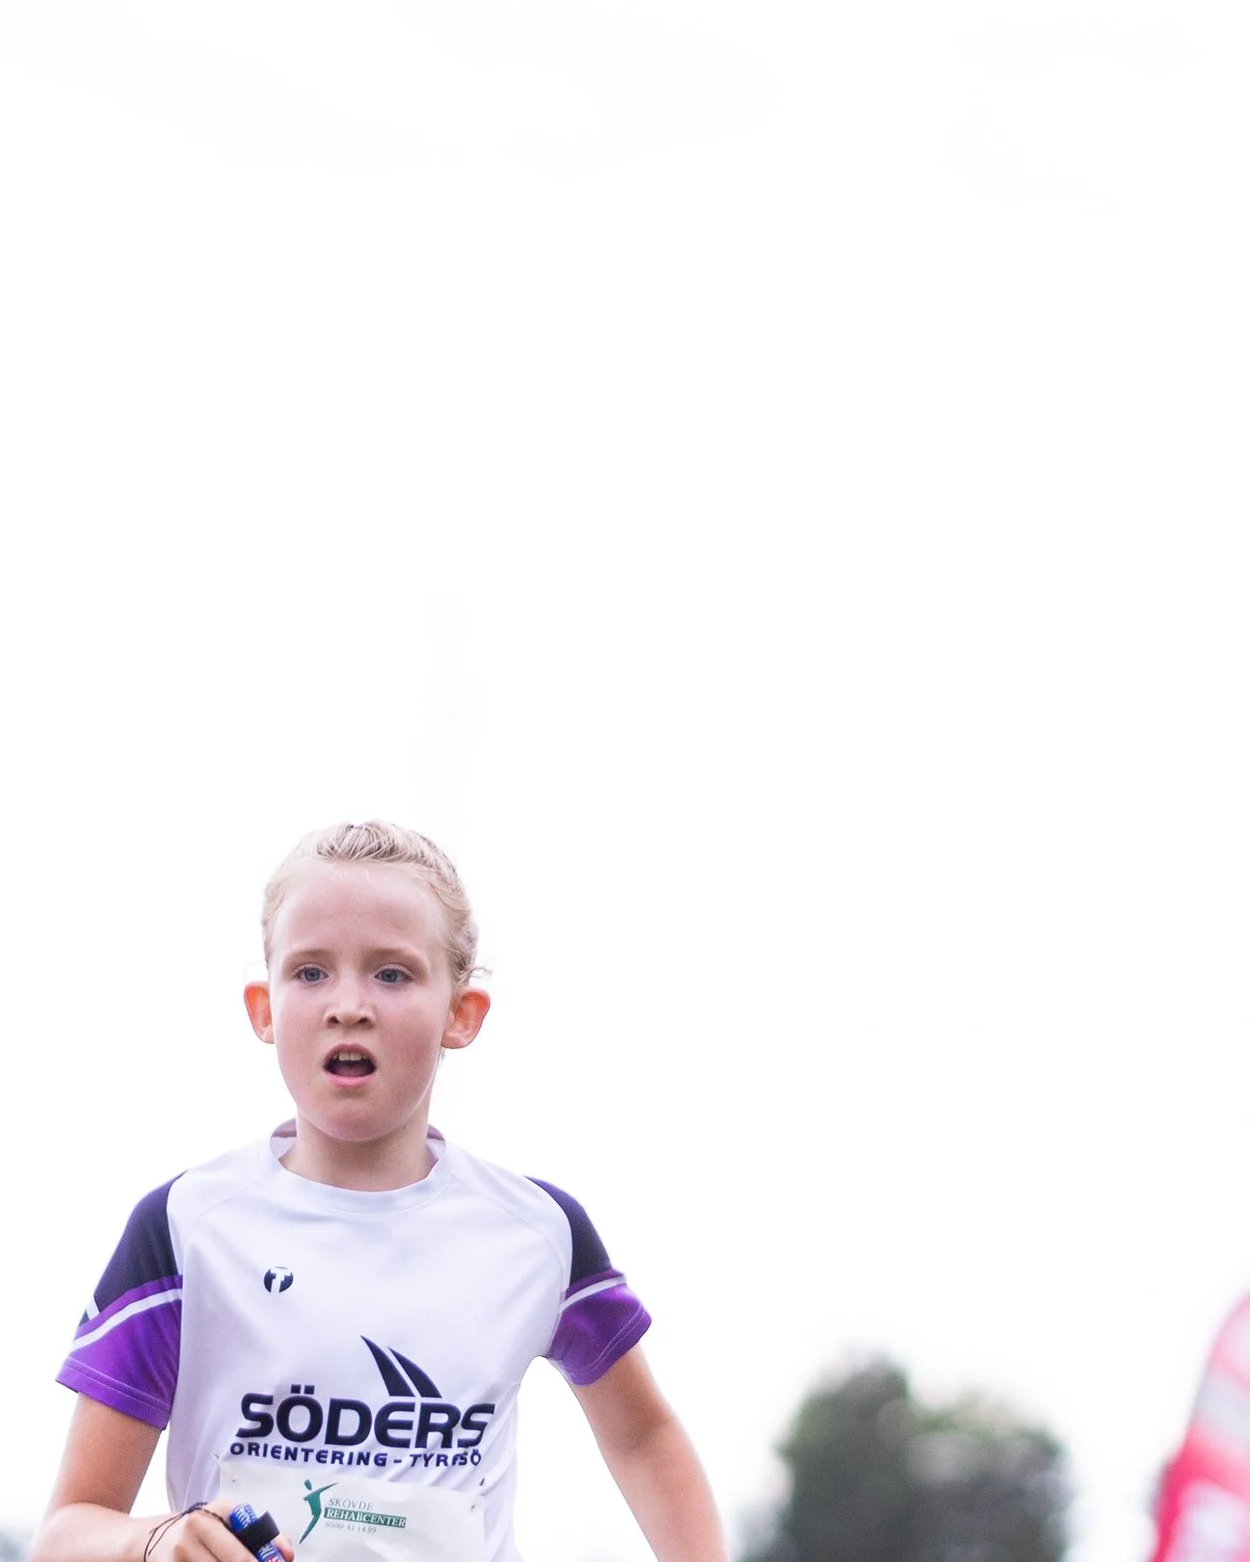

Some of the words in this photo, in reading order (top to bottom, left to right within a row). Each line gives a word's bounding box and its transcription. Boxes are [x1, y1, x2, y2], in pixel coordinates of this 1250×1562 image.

[235, 1384, 496, 1449] SÖDERS
[230, 1442, 387, 1467] ORIENTERING
[326, 1508, 406, 1528] REHABCENTER
